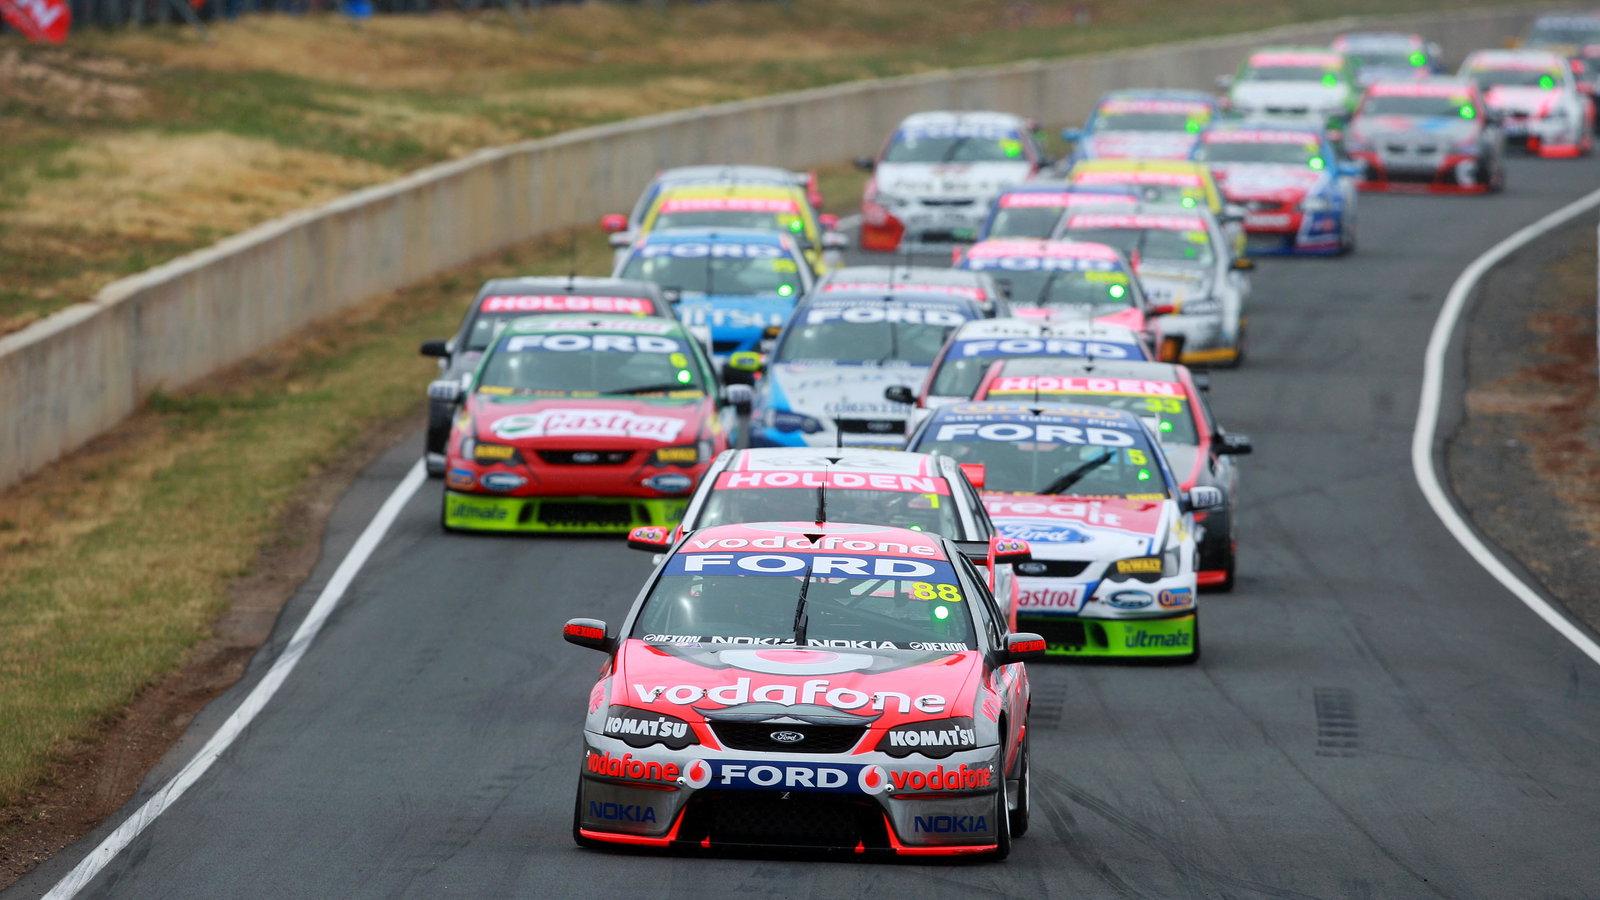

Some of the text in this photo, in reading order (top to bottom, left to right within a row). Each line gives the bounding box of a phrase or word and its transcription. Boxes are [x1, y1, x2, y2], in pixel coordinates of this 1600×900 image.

[642, 243, 782, 257] FORD
[489, 295, 642, 311] HOLDEN
[806, 307, 966, 327] FORD
[506, 334, 680, 353] FORD
[962, 339, 1128, 358] FORD
[999, 377, 1175, 396] HOLDEN
[1144, 397, 1183, 414] 33
[543, 413, 669, 435] Castrol
[936, 423, 1135, 447] FORD
[727, 472, 937, 492] HOLDEN
[988, 500, 1122, 526] redit
[692, 535, 937, 556] vodafone
[684, 553, 937, 577] FORD
[911, 581, 963, 603] 88
[1018, 588, 1077, 607] astrol
[807, 638, 899, 650] NOKIA
[923, 642, 969, 651] DEXION
[632, 677, 947, 714] vodafone
[605, 717, 689, 739] KOMATSU
[889, 724, 976, 747] KOMATSU
[588, 751, 680, 782] vodafone
[720, 764, 850, 788] FORD
[889, 763, 992, 790] vodafone
[589, 801, 657, 823] NOKIA
[914, 815, 988, 833] NOKIA
